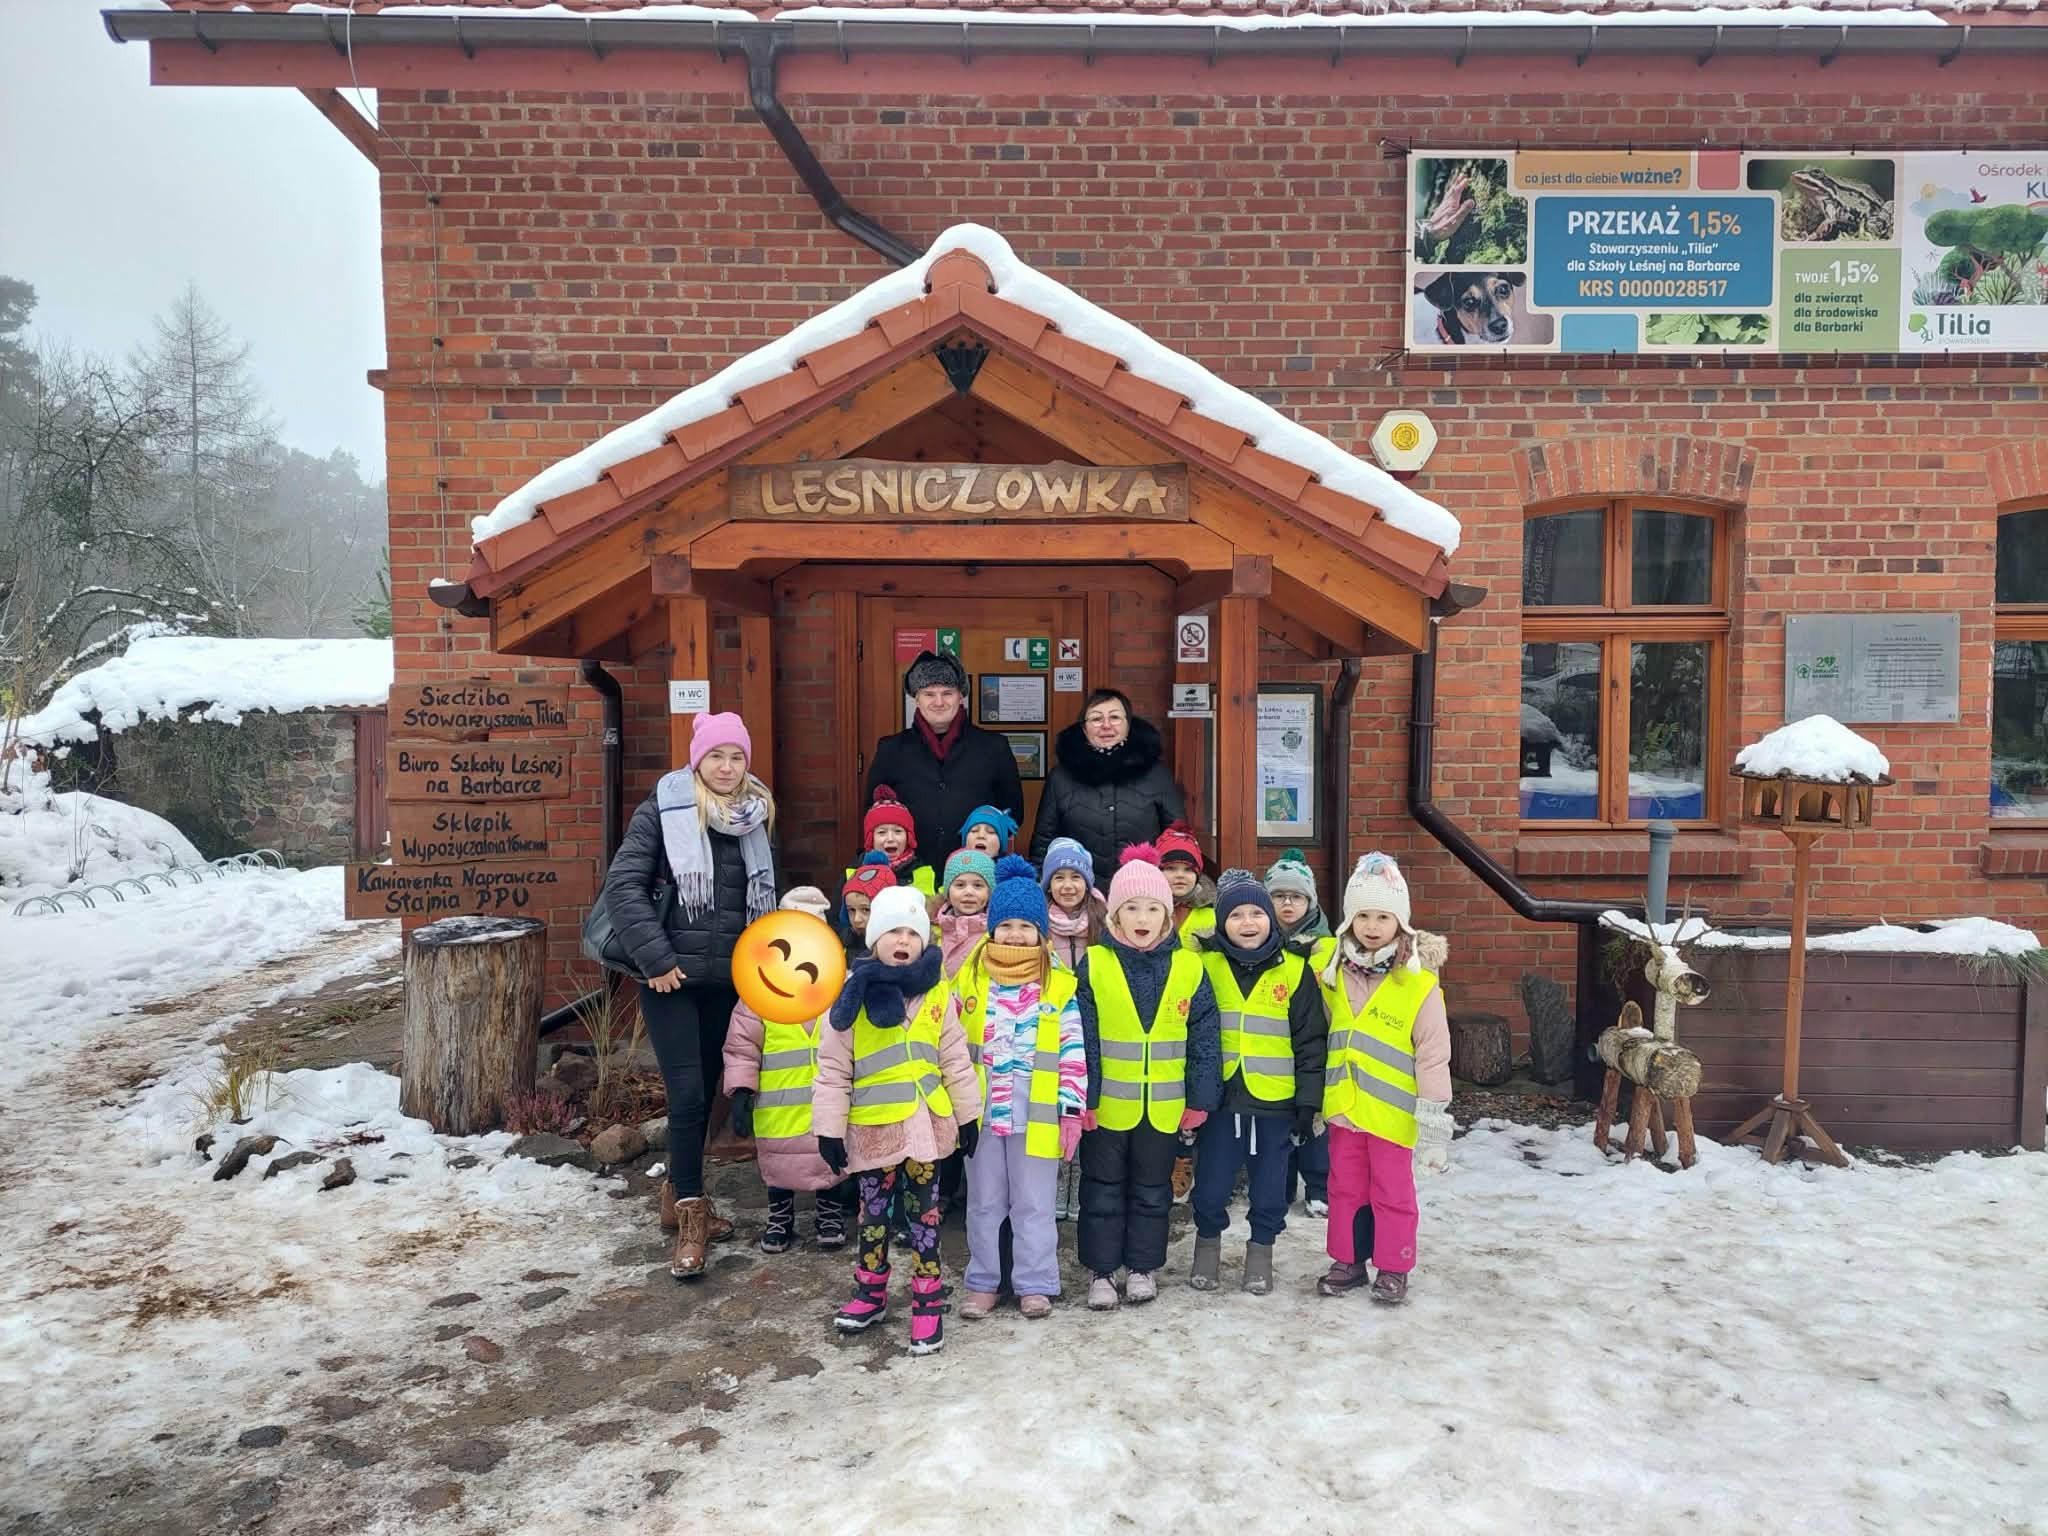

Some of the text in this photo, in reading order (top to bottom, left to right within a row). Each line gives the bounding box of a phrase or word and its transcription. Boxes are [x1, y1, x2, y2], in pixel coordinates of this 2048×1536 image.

[1525, 168, 1683, 186] co jest dla ciebie ważne?
[1978, 164, 2042, 177] Ośrodek
[1567, 204, 1742, 239] PRZEKAŻ 1,5%
[1589, 242, 1679, 257] Stowarzyszeniu
[1567, 259, 1741, 274] dla Szkoły Leśnej na Barbarce
[1794, 260, 1879, 287] TWOJE 1,5%
[1579, 279, 1728, 297] KRS 0000028517
[1794, 292, 1863, 305] dla zwierząt
[1793, 306, 1879, 318] dla środowiska
[1793, 321, 1864, 332] dla Barbarki
[687, 690, 702, 698] WC
[402, 699, 566, 729] Stowarzyszenia Tilia
[398, 752, 564, 779] Biuro Szkoły Leśnej
[426, 775, 542, 796] na Barbarce
[432, 811, 513, 839] Sklepik
[357, 866, 559, 893] Kawiarenka Naprawcza
[385, 890, 461, 914] Stajnia
